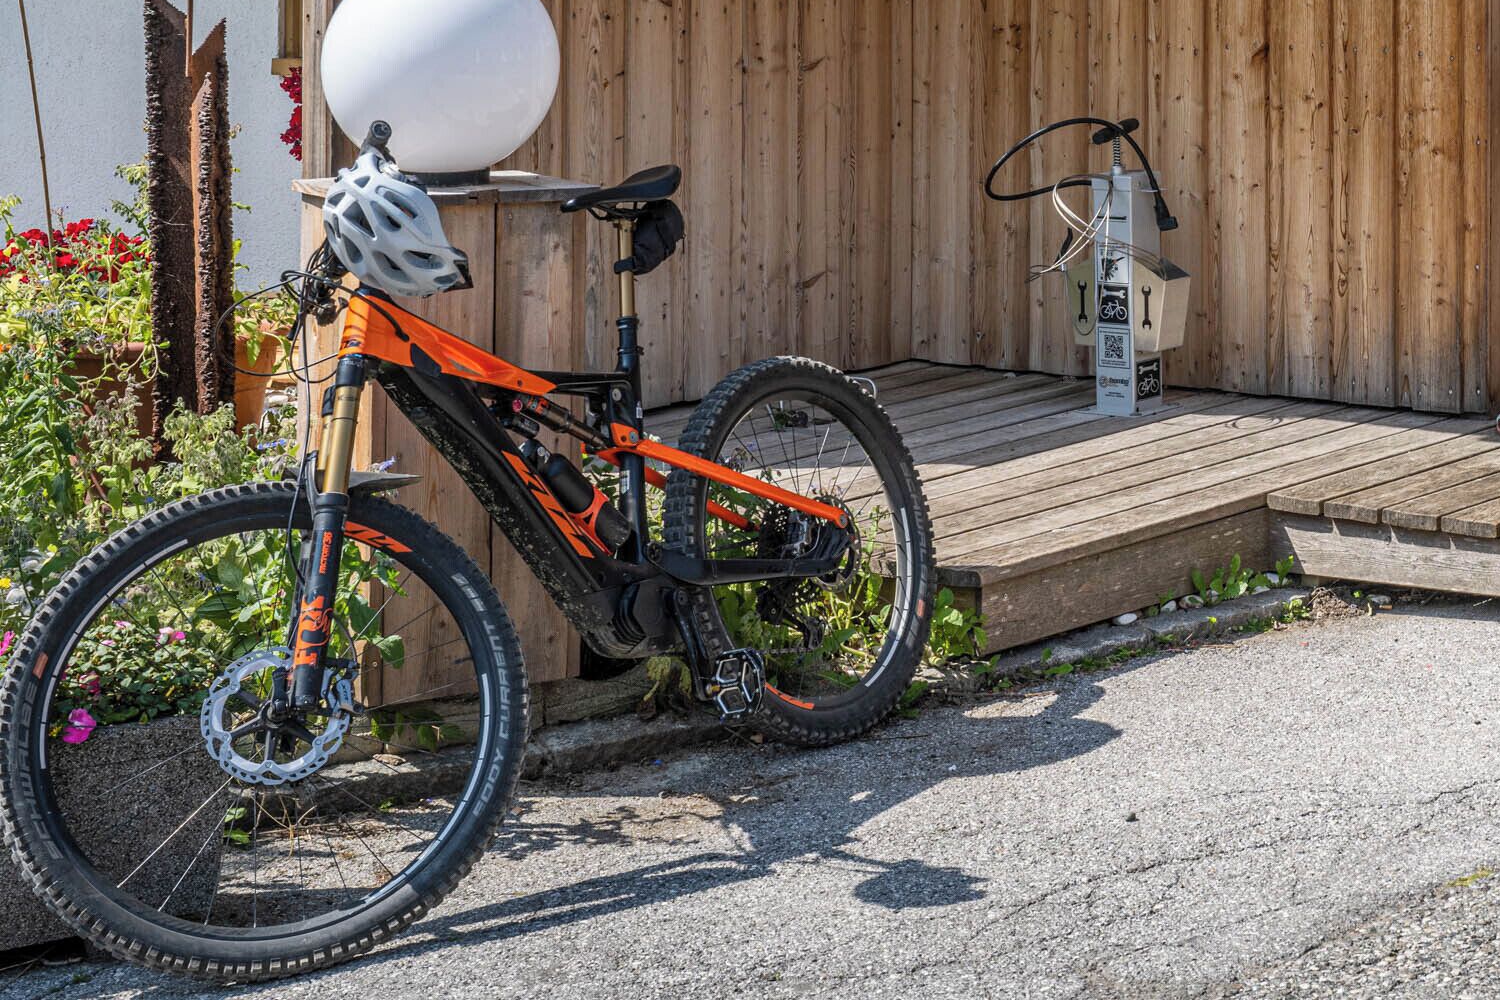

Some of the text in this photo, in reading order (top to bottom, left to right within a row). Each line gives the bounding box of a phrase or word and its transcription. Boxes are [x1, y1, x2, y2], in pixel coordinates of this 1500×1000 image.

[295, 594, 333, 667] FOX
[472, 620, 514, 818] EDDY CURRENT
[17, 681, 65, 860] SCHWALBE
